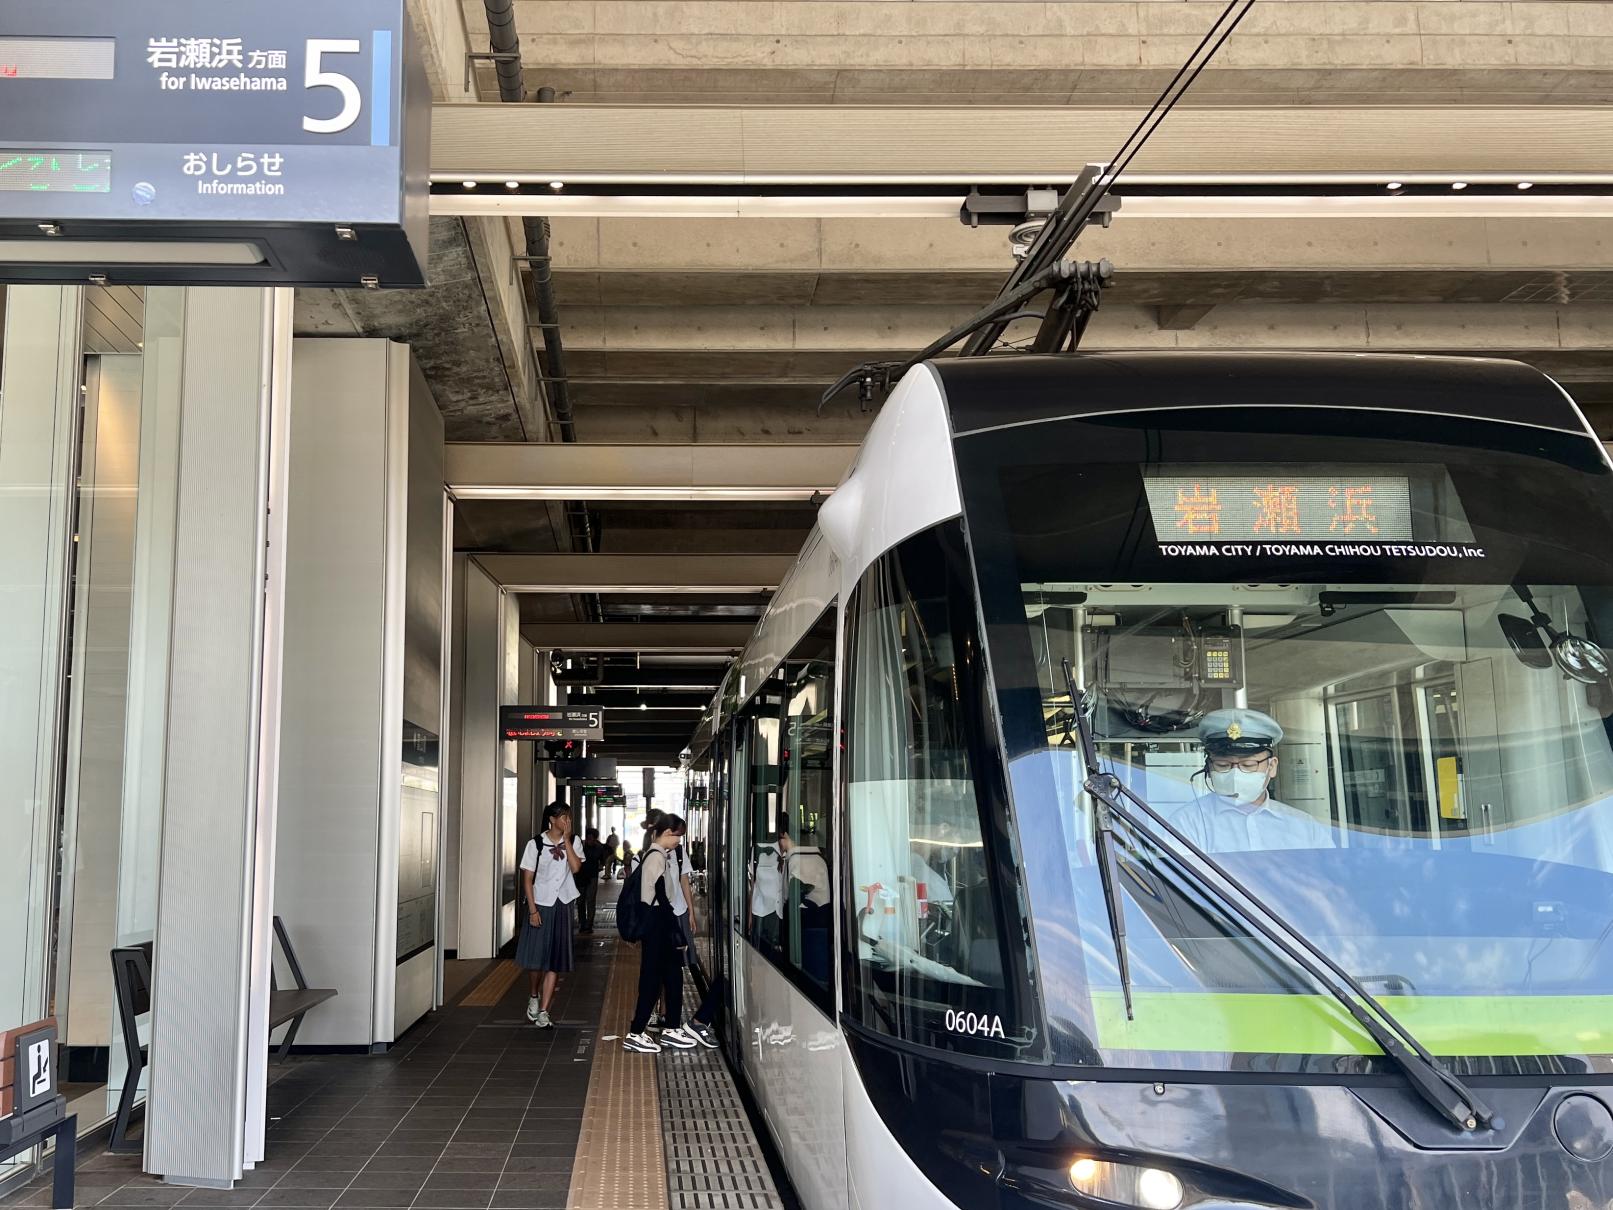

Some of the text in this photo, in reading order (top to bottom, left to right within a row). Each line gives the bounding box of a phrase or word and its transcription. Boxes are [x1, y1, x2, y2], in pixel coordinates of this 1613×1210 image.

[146, 37, 287, 68] 岩瀬浜 方面
[160, 72, 287, 90] for Iwasehama
[303, 39, 362, 133] 5
[183, 152, 284, 176] おしらせ
[198, 180, 284, 195] Information
[1175, 484, 1379, 534] 岩瀬浜
[1159, 545, 1219, 556] TOYAMA
[1221, 545, 1252, 556] CITY
[1263, 545, 1323, 556] TOYAMA
[1325, 545, 1381, 556] CHIHOU
[589, 712, 598, 727] 5
[946, 1009, 1005, 1039] 0604A
